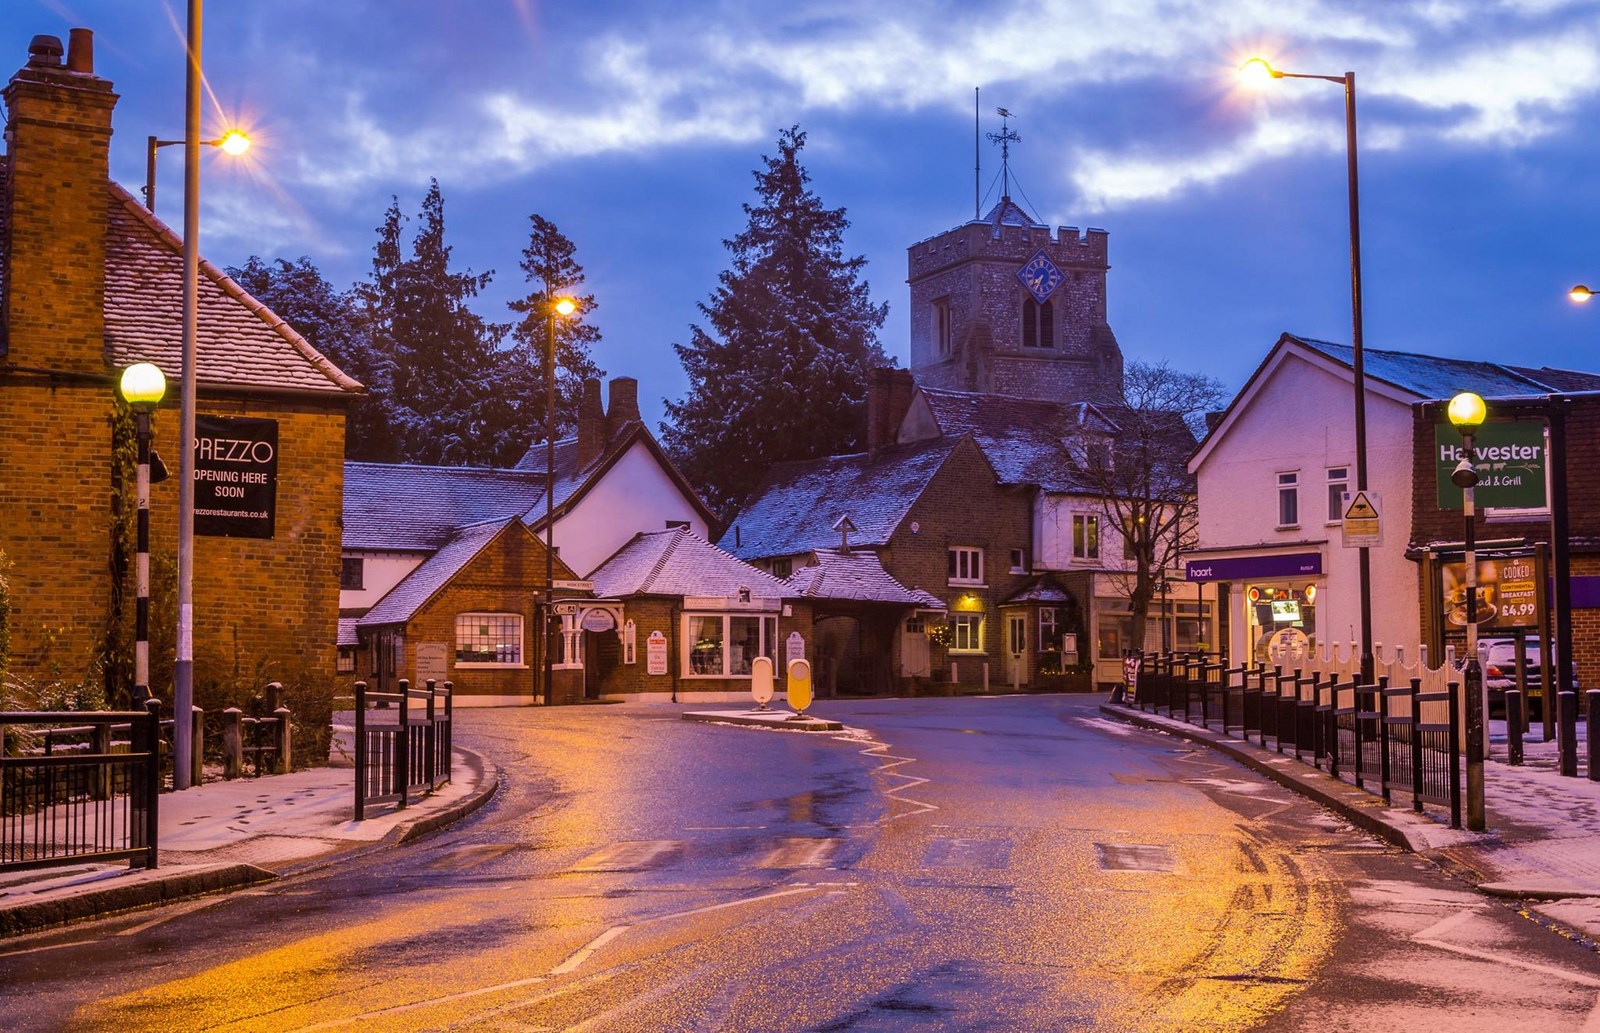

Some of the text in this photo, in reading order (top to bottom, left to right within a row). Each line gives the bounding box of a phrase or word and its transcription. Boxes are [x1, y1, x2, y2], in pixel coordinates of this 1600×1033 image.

[1440, 444, 1540, 461] Havester
[193, 470, 267, 484] OPENING HERE
[1493, 476, 1500, 486] &
[1502, 475, 1521, 486] Grill
[215, 486, 244, 498] SOON
[192, 508, 268, 518] rezzorestaurants.co.uk
[1190, 566, 1212, 577] haart
[1503, 565, 1530, 579] COOKED
[1501, 591, 1535, 599] BREAKFAST
[1502, 603, 1535, 616] £4.99
